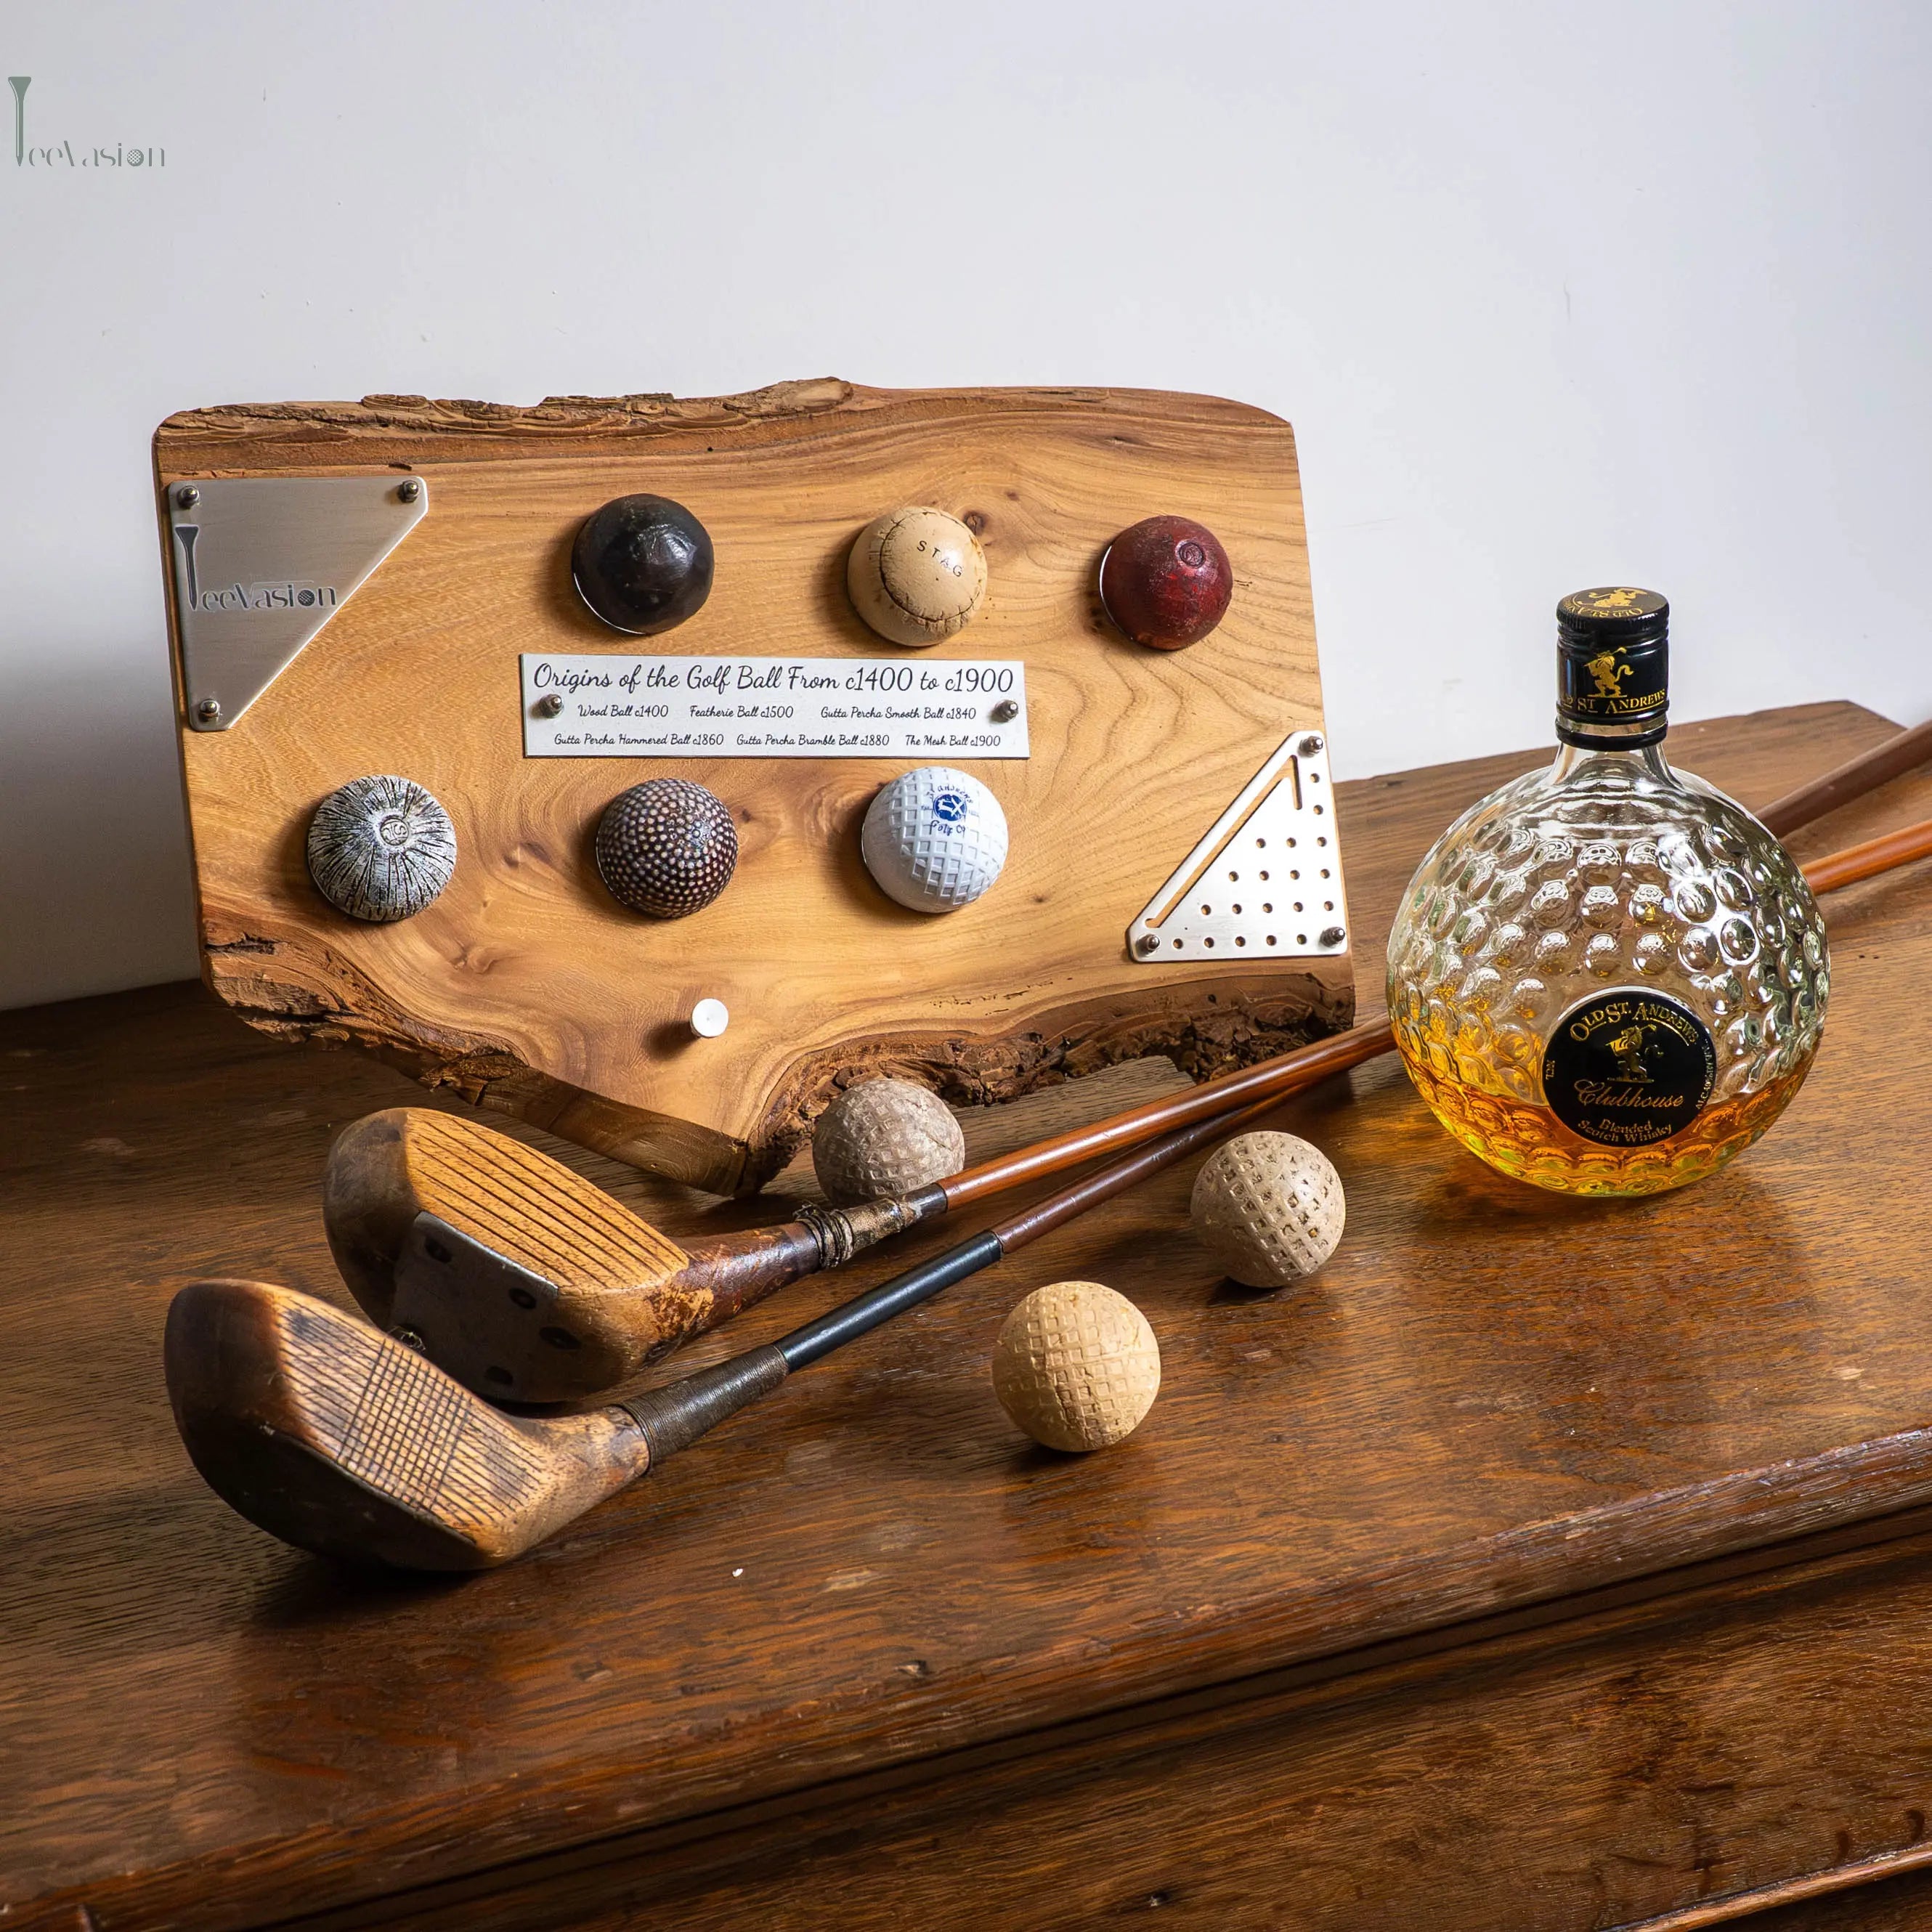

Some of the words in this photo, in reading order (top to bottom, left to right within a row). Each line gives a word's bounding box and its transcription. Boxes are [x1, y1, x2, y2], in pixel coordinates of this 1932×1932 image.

[916, 540, 963, 577] STAG
[534, 662, 612, 693] Origins
[619, 664, 641, 694] of
[646, 665, 680, 688] the
[686, 665, 731, 694] Golf
[737, 665, 781, 689] Ball
[788, 665, 840, 690] From
[845, 667, 913, 691] c1400
[920, 670, 940, 689] to
[945, 667, 1014, 692] c1900
[578, 705, 607, 717] Wood
[611, 705, 633, 717] Ball
[635, 705, 669, 718] c1400
[690, 705, 734, 718] Featherie
[737, 705, 758, 718] Ball
[760, 706, 794, 718] c1500
[821, 707, 848, 718] Gutta
[851, 707, 883, 719] Percha
[885, 707, 921, 719] Smooth
[924, 707, 945, 719] Ball
[946, 707, 976, 720] c1840
[554, 734, 581, 745] Gutta
[584, 734, 616, 745] Percha
[619, 734, 667, 745] Hammered
[670, 734, 691, 745] Ball
[692, 734, 724, 746] c1860
[736, 734, 762, 746] Gutta
[765, 734, 795, 746] Percha
[798, 734, 836, 746] Bramble
[839, 734, 858, 746] Ball
[860, 734, 890, 747] c1880
[906, 734, 920, 747] The
[923, 734, 946, 747] Mesh
[949, 735, 969, 747] Ball
[970, 735, 1001, 747] c1900
[1574, 1079, 1684, 1108] Clubhouse
[1578, 1119, 1619, 1142] Scotch
[1599, 1119, 1652, 1135] Blended
